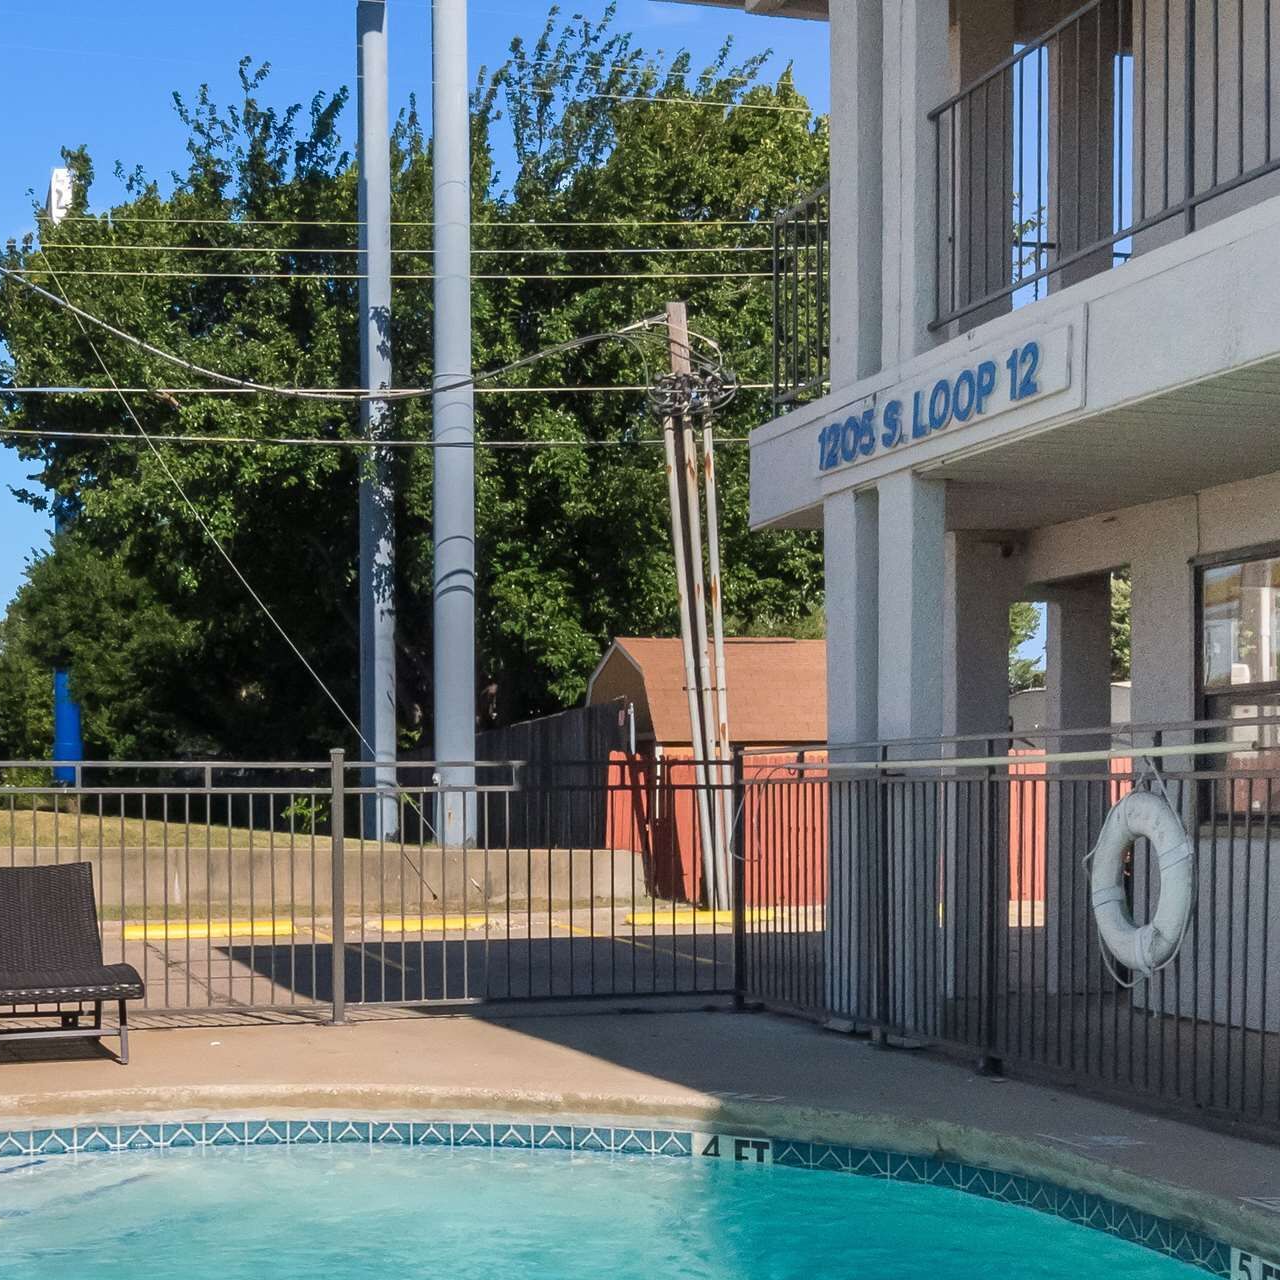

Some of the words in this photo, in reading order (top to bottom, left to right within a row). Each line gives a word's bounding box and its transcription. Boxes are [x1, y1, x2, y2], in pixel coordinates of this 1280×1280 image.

[818, 408, 876, 471] 1205
[912, 360, 996, 439] LOOP
[1006, 341, 1039, 401] 12
[702, 1135, 720, 1157] 4
[735, 1138, 770, 1163] FT
